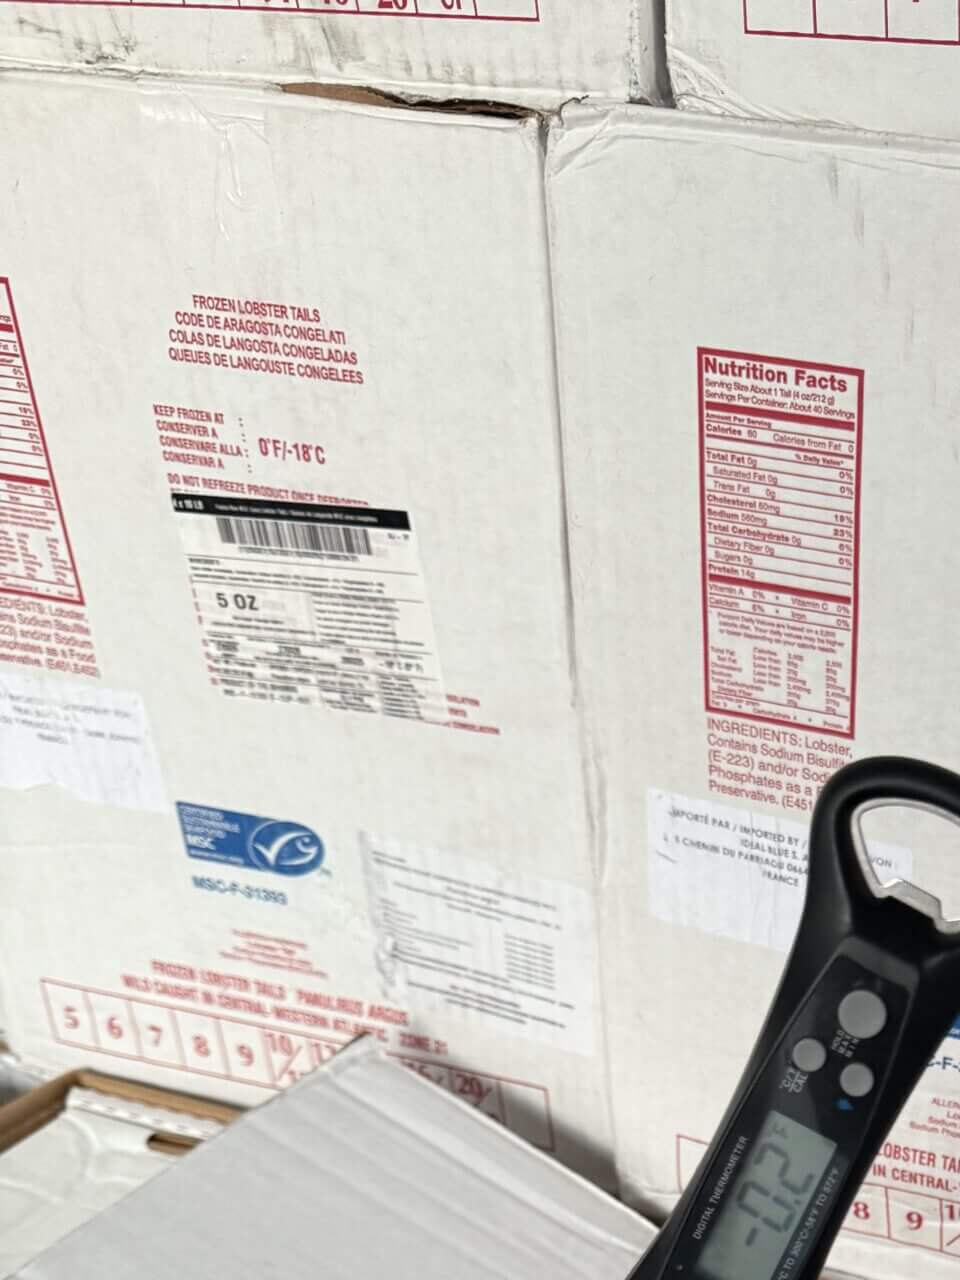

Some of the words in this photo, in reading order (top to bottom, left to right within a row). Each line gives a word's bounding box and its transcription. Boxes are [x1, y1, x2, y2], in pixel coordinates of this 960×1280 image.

[192, 295, 235, 313] FROZEN
[238, 301, 287, 319] LOBSTER
[291, 308, 320, 323] TAILS
[175, 312, 203, 326] CODE
[207, 316, 221, 329] DE
[223, 319, 281, 336] ARAGOSTA
[283, 326, 346, 345] CONGELATI
[169, 329, 204, 345] COLAS
[207, 334, 220, 348] DE
[223, 336, 280, 355] LANGOSTA
[283, 343, 357, 365] CONGELADAS
[169, 348, 211, 365] QUEUES
[213, 353, 227, 367] DE
[230, 355, 295, 376] LANGOUSTE
[297, 364, 363, 384] CONGELEES
[704, 357, 787, 385] Nutrition
[795, 370, 847, 393] Facts
[215, 591, 229, 609] 5
[234, 593, 259, 612] OZ
[707, 718, 803, 747] INGREDIENTS:
[805, 738, 852, 758] Lobster,
[707, 734, 758, 754] Contains
[761, 745, 804, 763] Sodium
[708, 750, 755, 770] (E-223)
[758, 762, 798, 778] and/or
[709, 765, 783, 790] Phosphates
[786, 783, 800, 793] as
[805, 787, 813, 797] a
[709, 780, 780, 805] Preservative.
[782, 795, 814, 812] (E451
[64, 1006, 80, 1030] 5
[106, 1016, 123, 1040] 6
[148, 1024, 162, 1047] 7
[238, 1044, 255, 1067] 9
[873, 1165, 886, 1178] IN
[692, 1206, 715, 1240] DIGITAL
[711, 1136, 749, 1204] THERMOMETER
[853, 1201, 870, 1220] 8
[906, 1211, 923, 1231] 9
